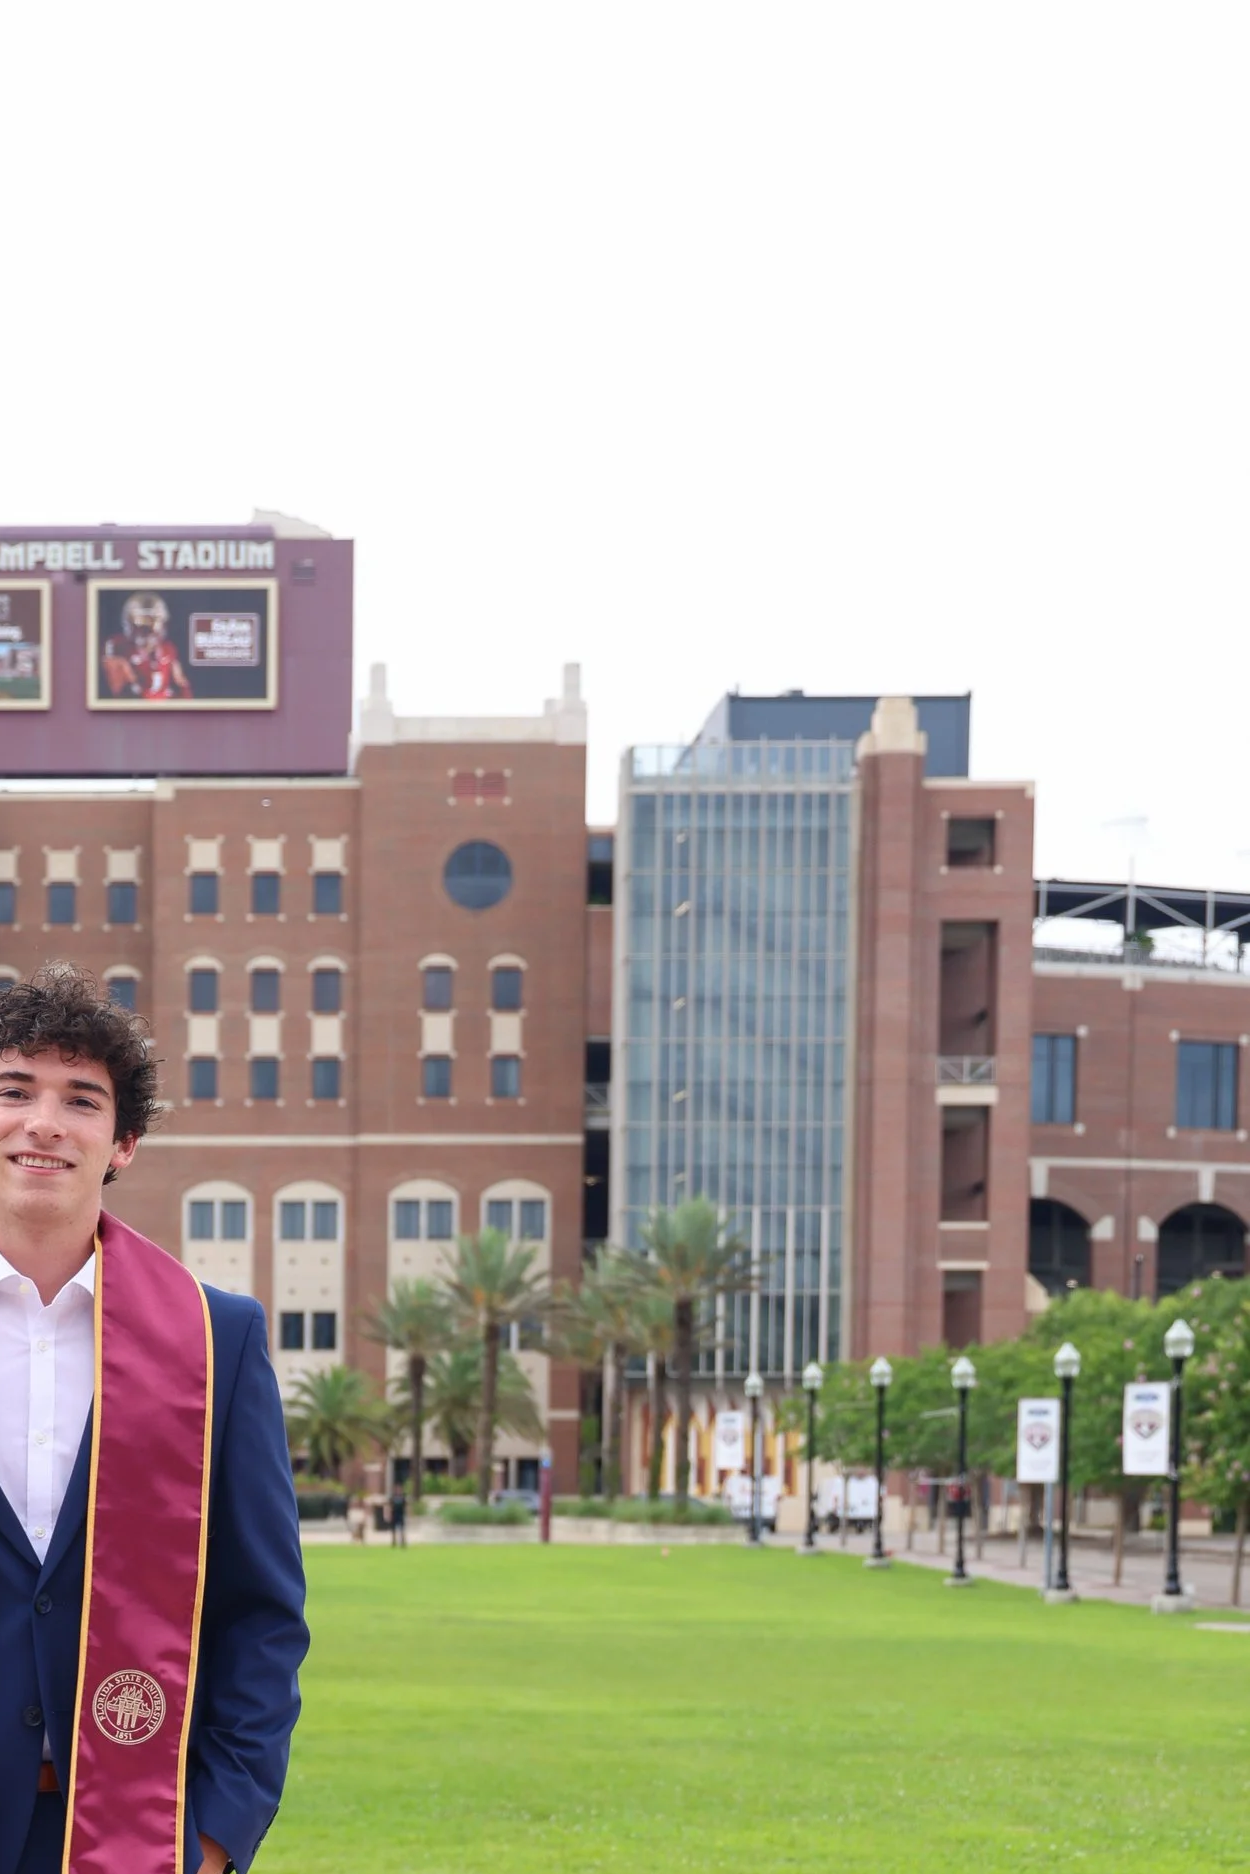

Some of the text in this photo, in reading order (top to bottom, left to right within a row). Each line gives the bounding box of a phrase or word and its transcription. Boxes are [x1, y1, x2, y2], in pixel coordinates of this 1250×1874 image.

[137, 541, 275, 570] STADIUM
[96, 1674, 162, 1731] FLORIDA STATE UNIVERSITY
[115, 1730, 133, 1740] 1851
